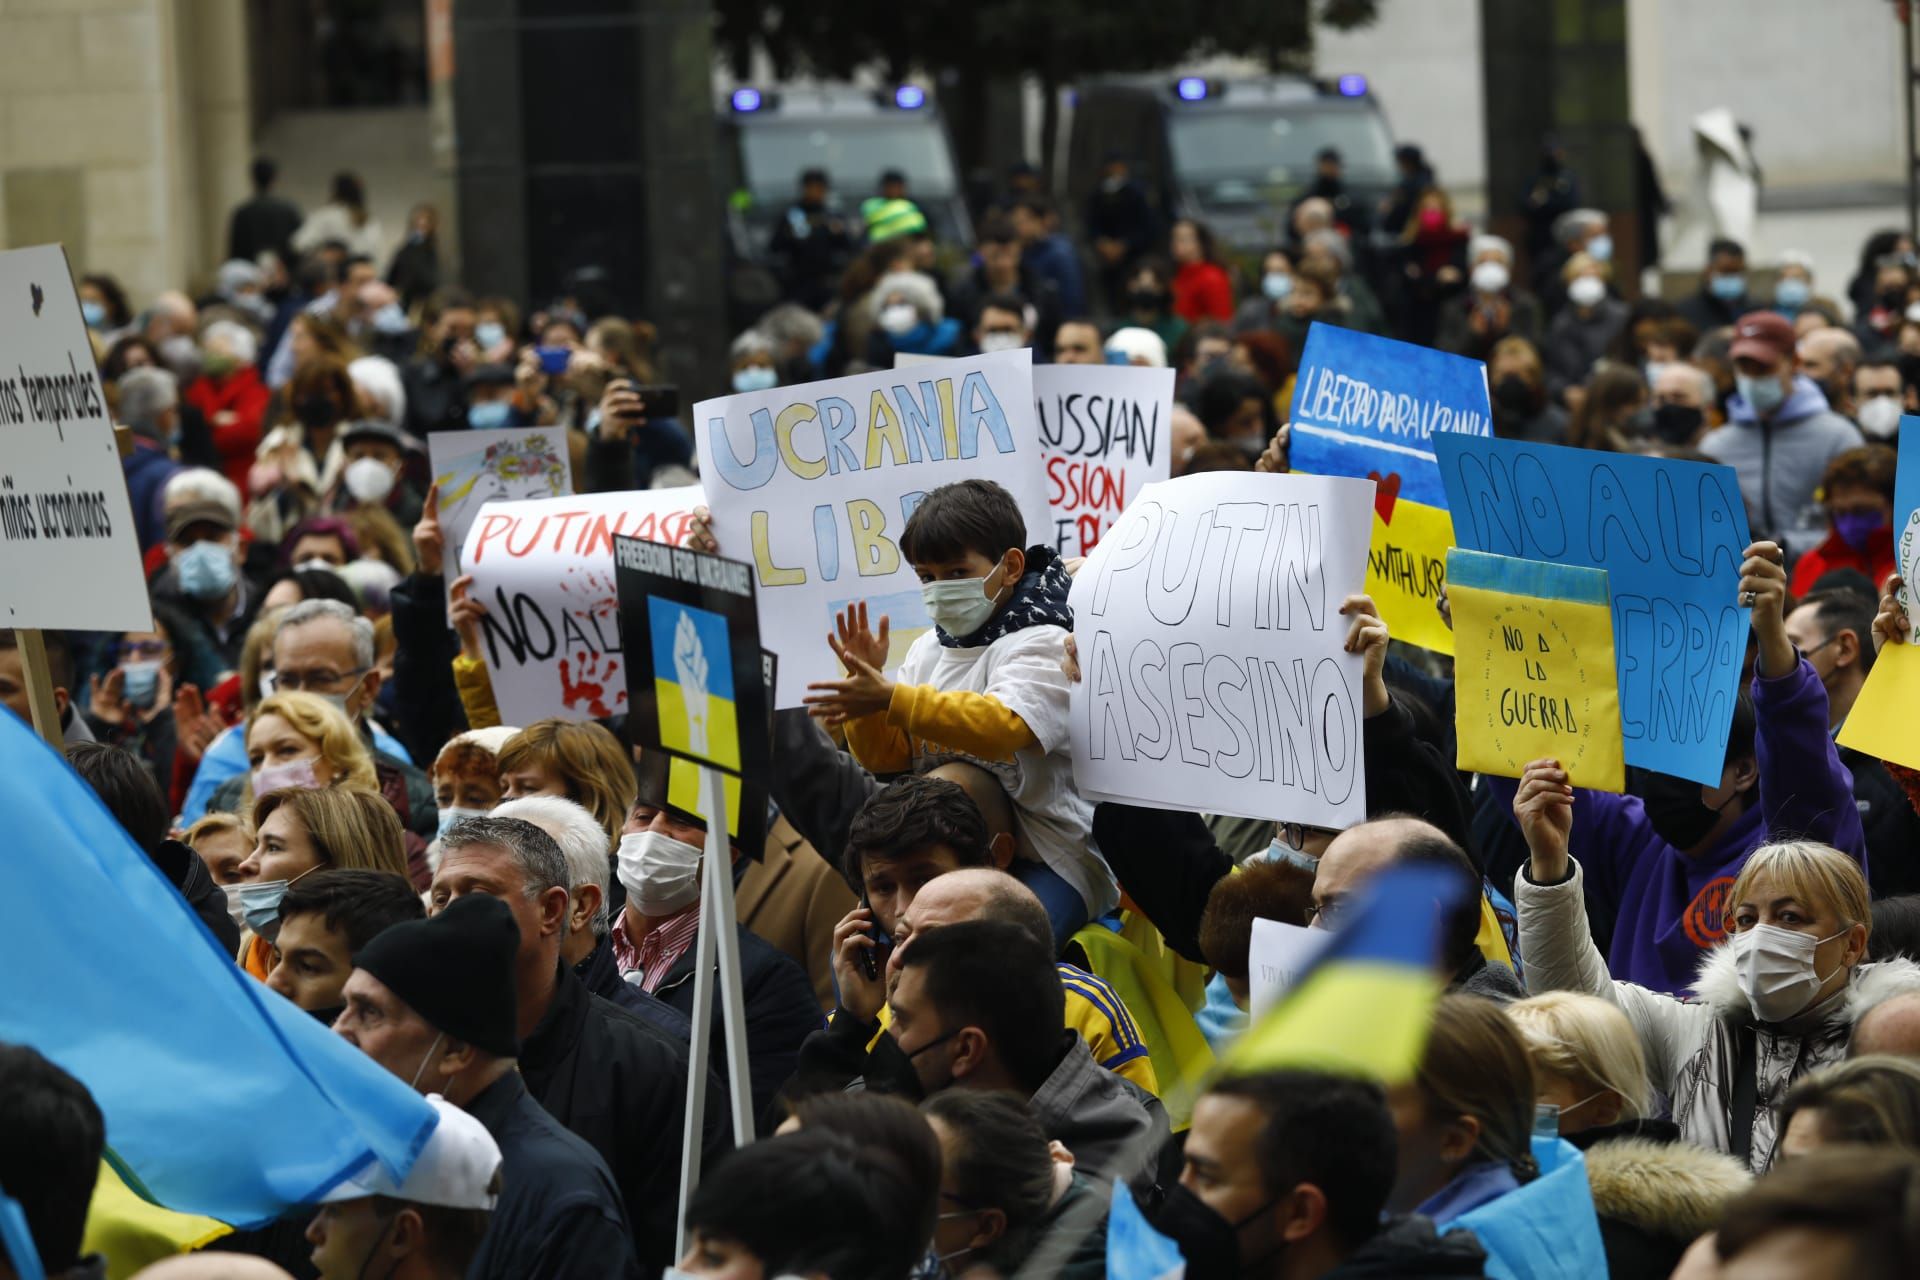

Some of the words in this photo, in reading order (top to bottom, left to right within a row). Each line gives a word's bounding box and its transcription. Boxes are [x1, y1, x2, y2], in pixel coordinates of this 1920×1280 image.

[1038, 393, 1158, 467] USSIAN
[1298, 365, 1379, 428] LIBERTAD
[708, 371, 1015, 491] UCRANIA
[1043, 455, 1124, 513] SSION
[1458, 452, 1567, 559] NO
[1588, 464, 1651, 563] A
[1655, 468, 1752, 578] LA
[473, 511, 628, 564] PUTIN
[1091, 501, 1325, 631] PUTIN
[1410, 552, 1445, 601] UKR
[472, 586, 558, 670] NO
[1502, 625, 1524, 652] NO
[1525, 657, 1547, 681] LA
[1615, 594, 1740, 748] ERRA
[1089, 630, 1357, 805] ASESINO
[1500, 688, 1578, 735] GUERRA
